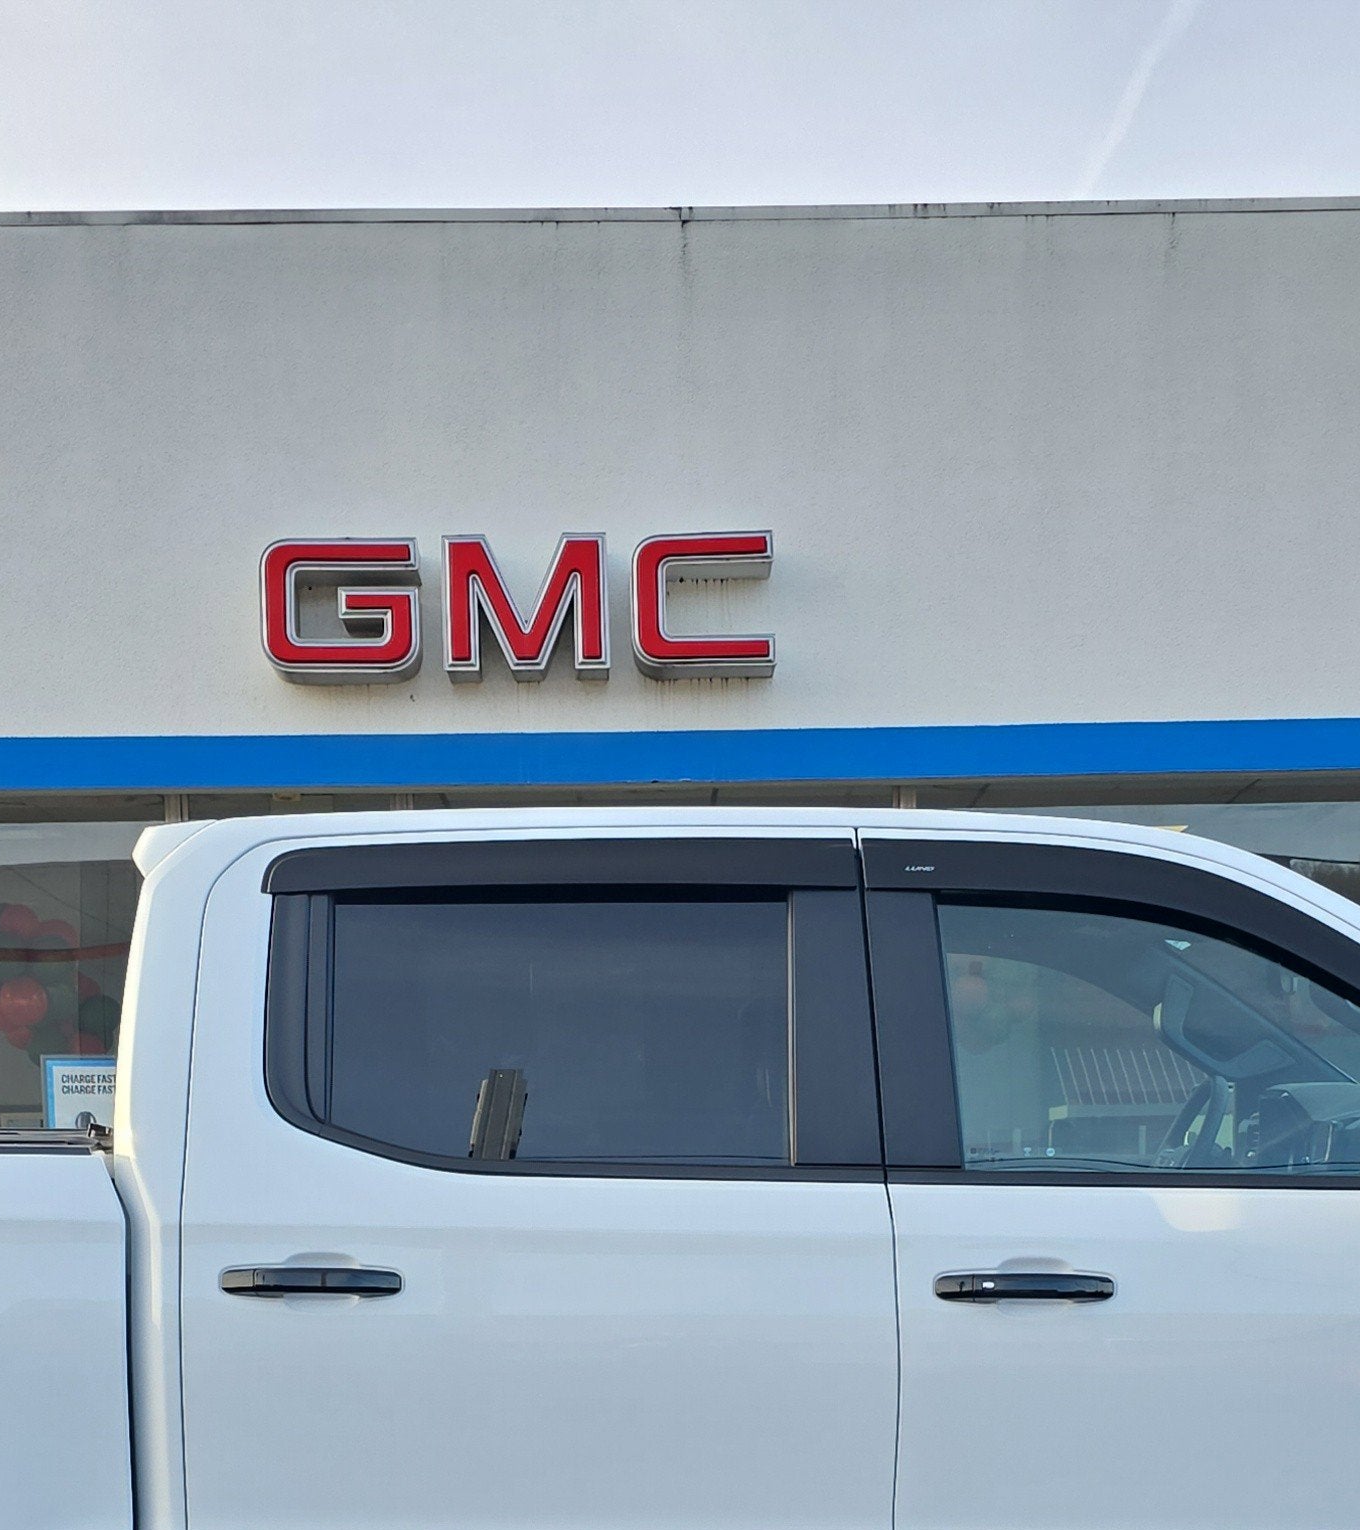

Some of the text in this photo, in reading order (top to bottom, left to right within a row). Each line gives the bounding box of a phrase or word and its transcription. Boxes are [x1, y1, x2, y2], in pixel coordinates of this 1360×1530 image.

[259, 531, 777, 685] GMC
[61, 1074, 95, 1084] CHARGE
[61, 1085, 95, 1095] CHARGE
